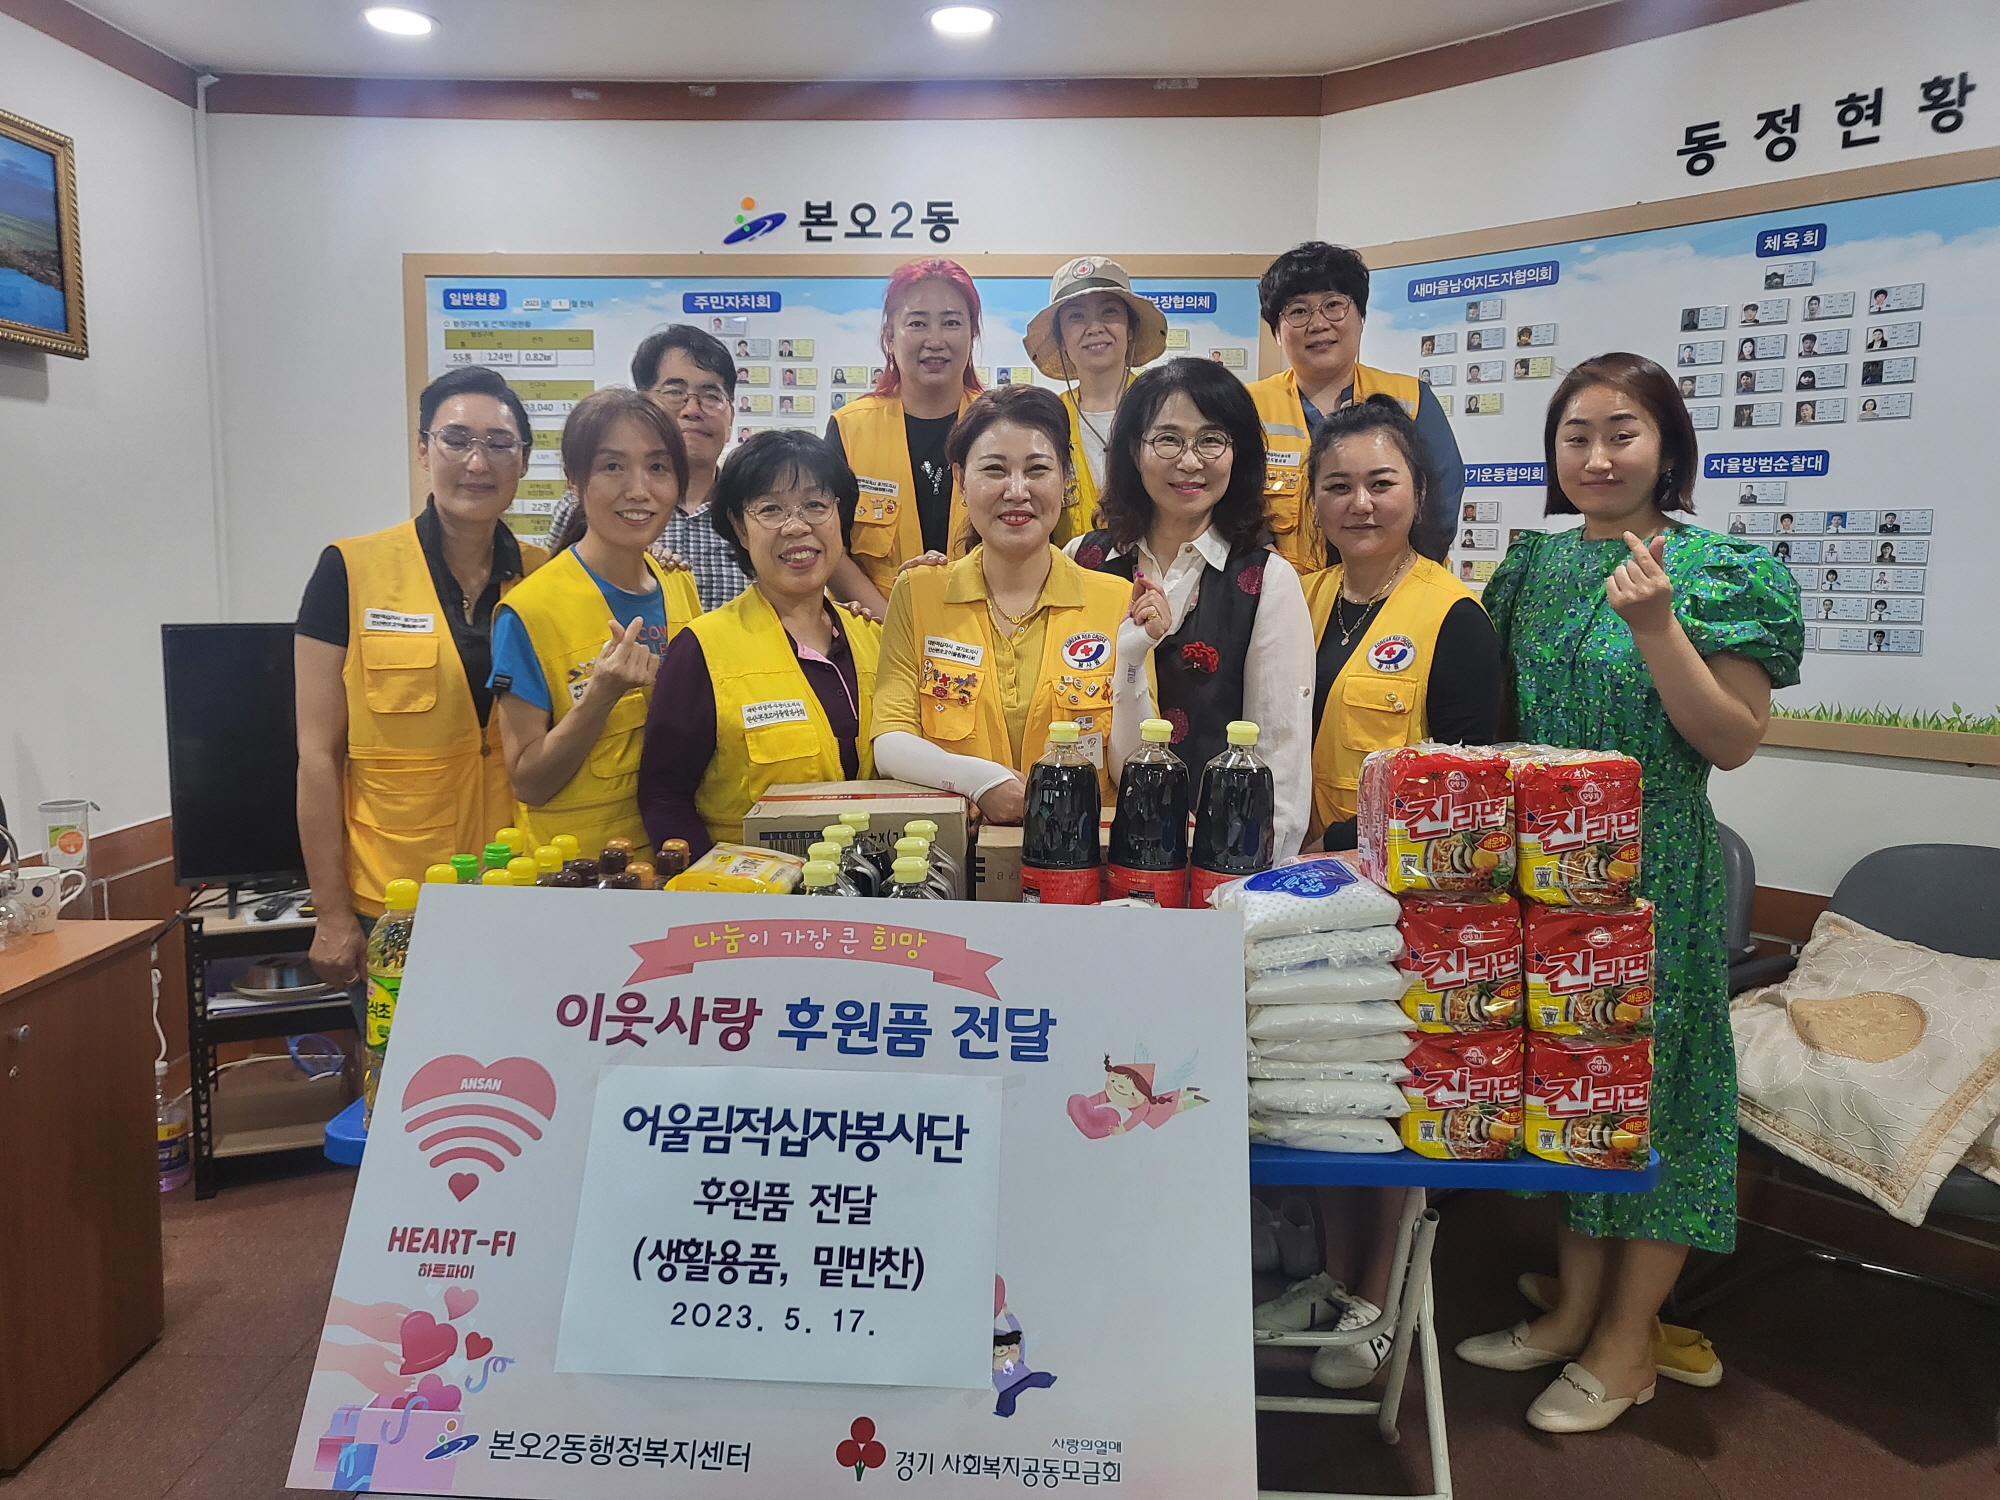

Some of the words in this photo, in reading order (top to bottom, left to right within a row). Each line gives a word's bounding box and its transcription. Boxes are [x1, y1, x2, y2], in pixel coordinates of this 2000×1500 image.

[1676, 71, 1977, 176] 동정현황
[798, 200, 959, 243] 본오2동
[1763, 229, 1820, 252] 체육회
[449, 292, 501, 307] 일반현황
[693, 294, 771, 310] 주민자치회
[1710, 455, 1823, 474] 자율방범순찰대
[1405, 794, 1508, 841] 진라면
[1538, 806, 1640, 855] 진라면
[693, 924, 768, 954] 나눔이
[781, 927, 832, 950] 가장
[838, 927, 860, 955] 큰
[871, 925, 928, 959] 희망
[1421, 947, 1520, 992] 진라면
[1545, 948, 1649, 995] 진라면
[367, 999, 392, 1020] 식초
[556, 991, 763, 1052] 이웃사랑
[777, 996, 932, 1058] 후원품
[951, 1005, 1057, 1062] 전달
[460, 1077, 503, 1092] ANSAN
[1423, 1067, 1521, 1110] 진라면
[1544, 1076, 1650, 1119] 진라면
[622, 1102, 970, 1164] 어울림적십자봉사단
[693, 1176, 795, 1222] 후원품
[809, 1183, 878, 1225] 전달
[387, 1225, 517, 1257] HEART-FI
[417, 1262, 475, 1280] 하트파이
[633, 1236, 788, 1287] (생활용품,
[813, 1245, 925, 1291] 밑반찬)
[670, 1302, 763, 1332] 2023.
[784, 1307, 812, 1334] 5.
[832, 1309, 876, 1336] 17.
[488, 1429, 752, 1473] 본오2동행정복지센터
[1051, 1437, 1122, 1456] 사랑의열매
[895, 1451, 934, 1482] 경기
[941, 1453, 1122, 1488] 사회복지공동모금회
